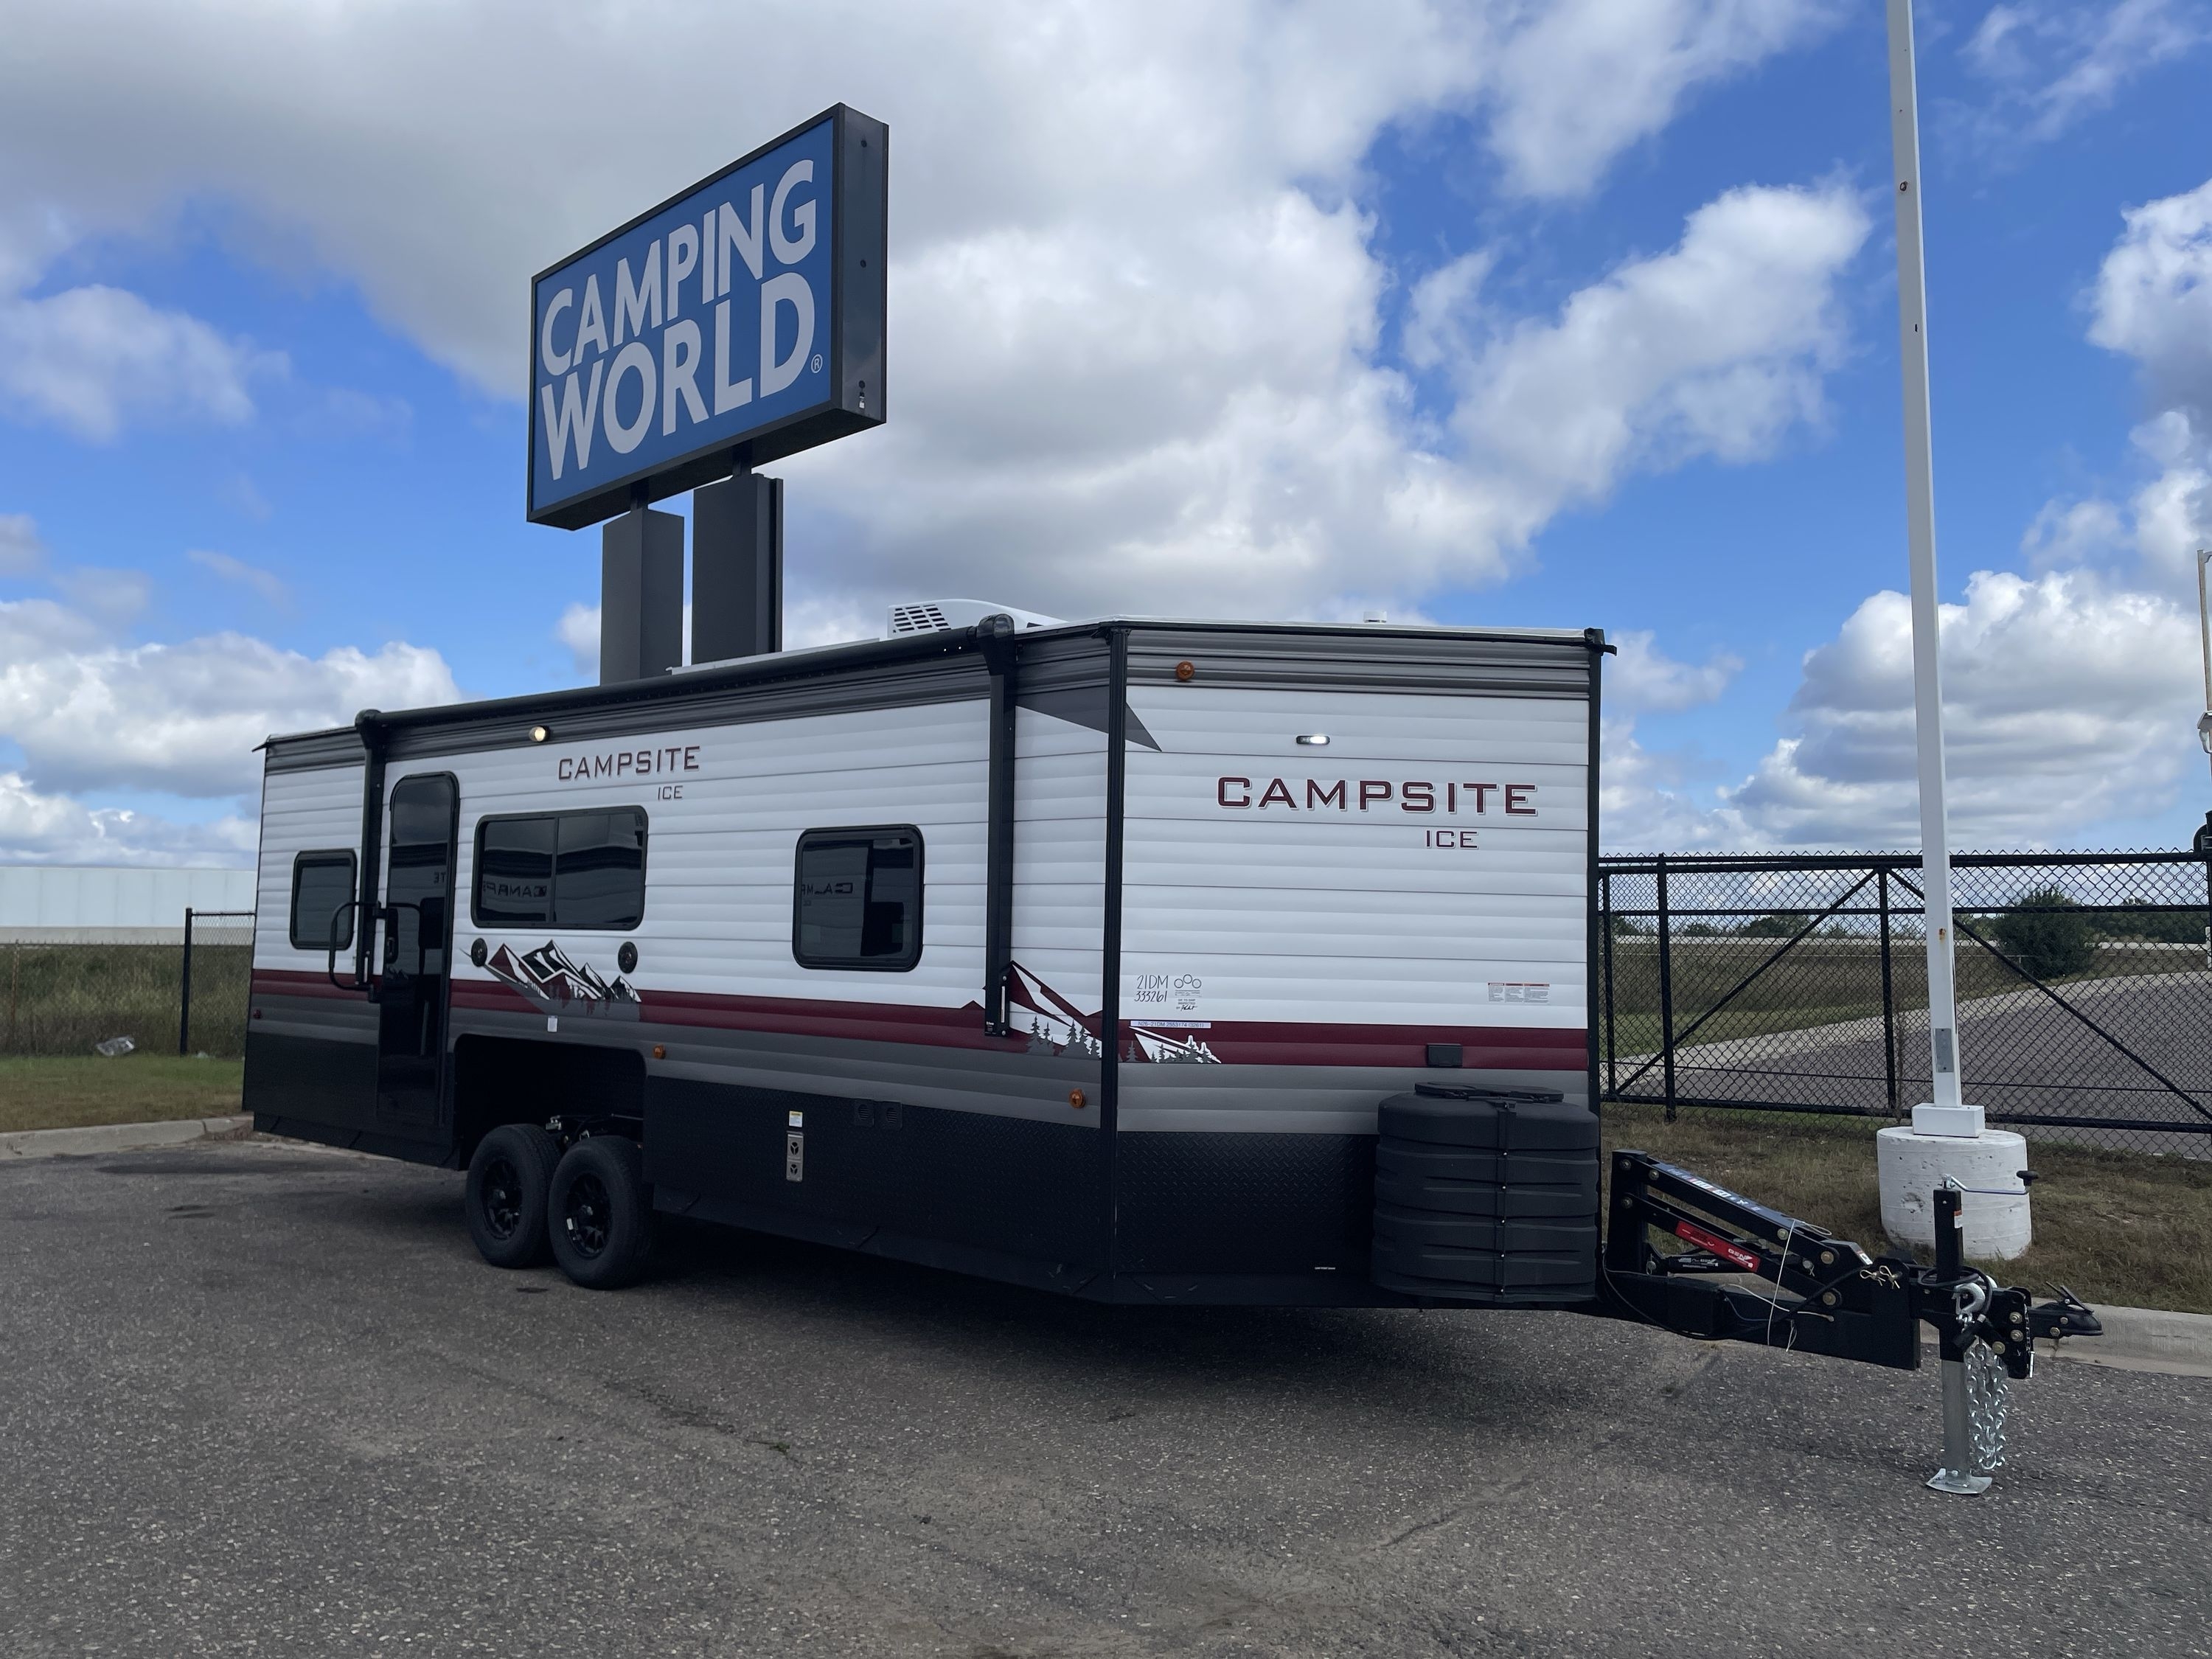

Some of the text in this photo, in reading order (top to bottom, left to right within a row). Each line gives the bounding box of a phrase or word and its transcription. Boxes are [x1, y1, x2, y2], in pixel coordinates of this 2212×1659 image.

[541, 159, 817, 376] CAMPING
[558, 745, 700, 780] CAMPSITE
[657, 785, 684, 801] ICE
[1217, 776, 1538, 816] CAMPSITE
[1425, 830, 1479, 849] ICE
[1136, 975, 1169, 990] 21DM
[1134, 990, 1167, 1003] 333261
